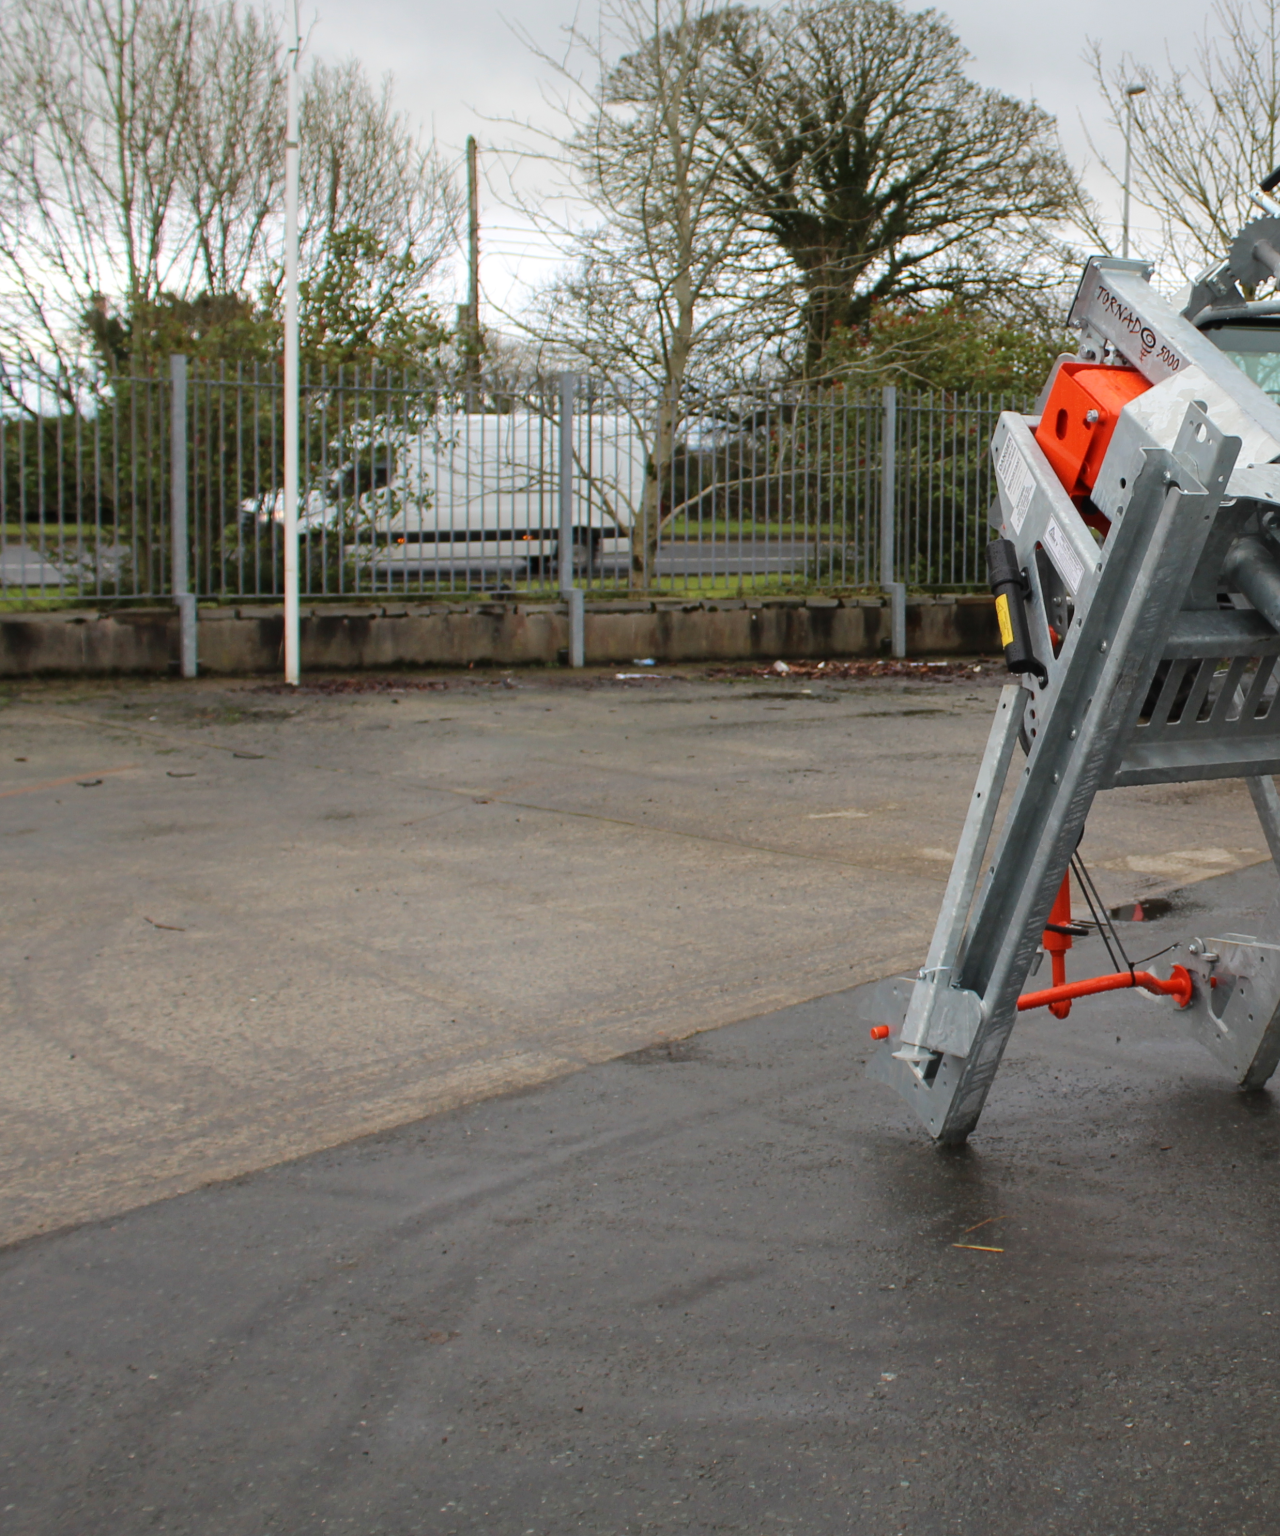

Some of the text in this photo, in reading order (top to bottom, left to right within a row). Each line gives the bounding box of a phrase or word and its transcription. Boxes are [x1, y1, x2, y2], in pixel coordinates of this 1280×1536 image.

[1097, 285, 1180, 371] TORNADO 5000
[998, 434, 1012, 471] DANGER
